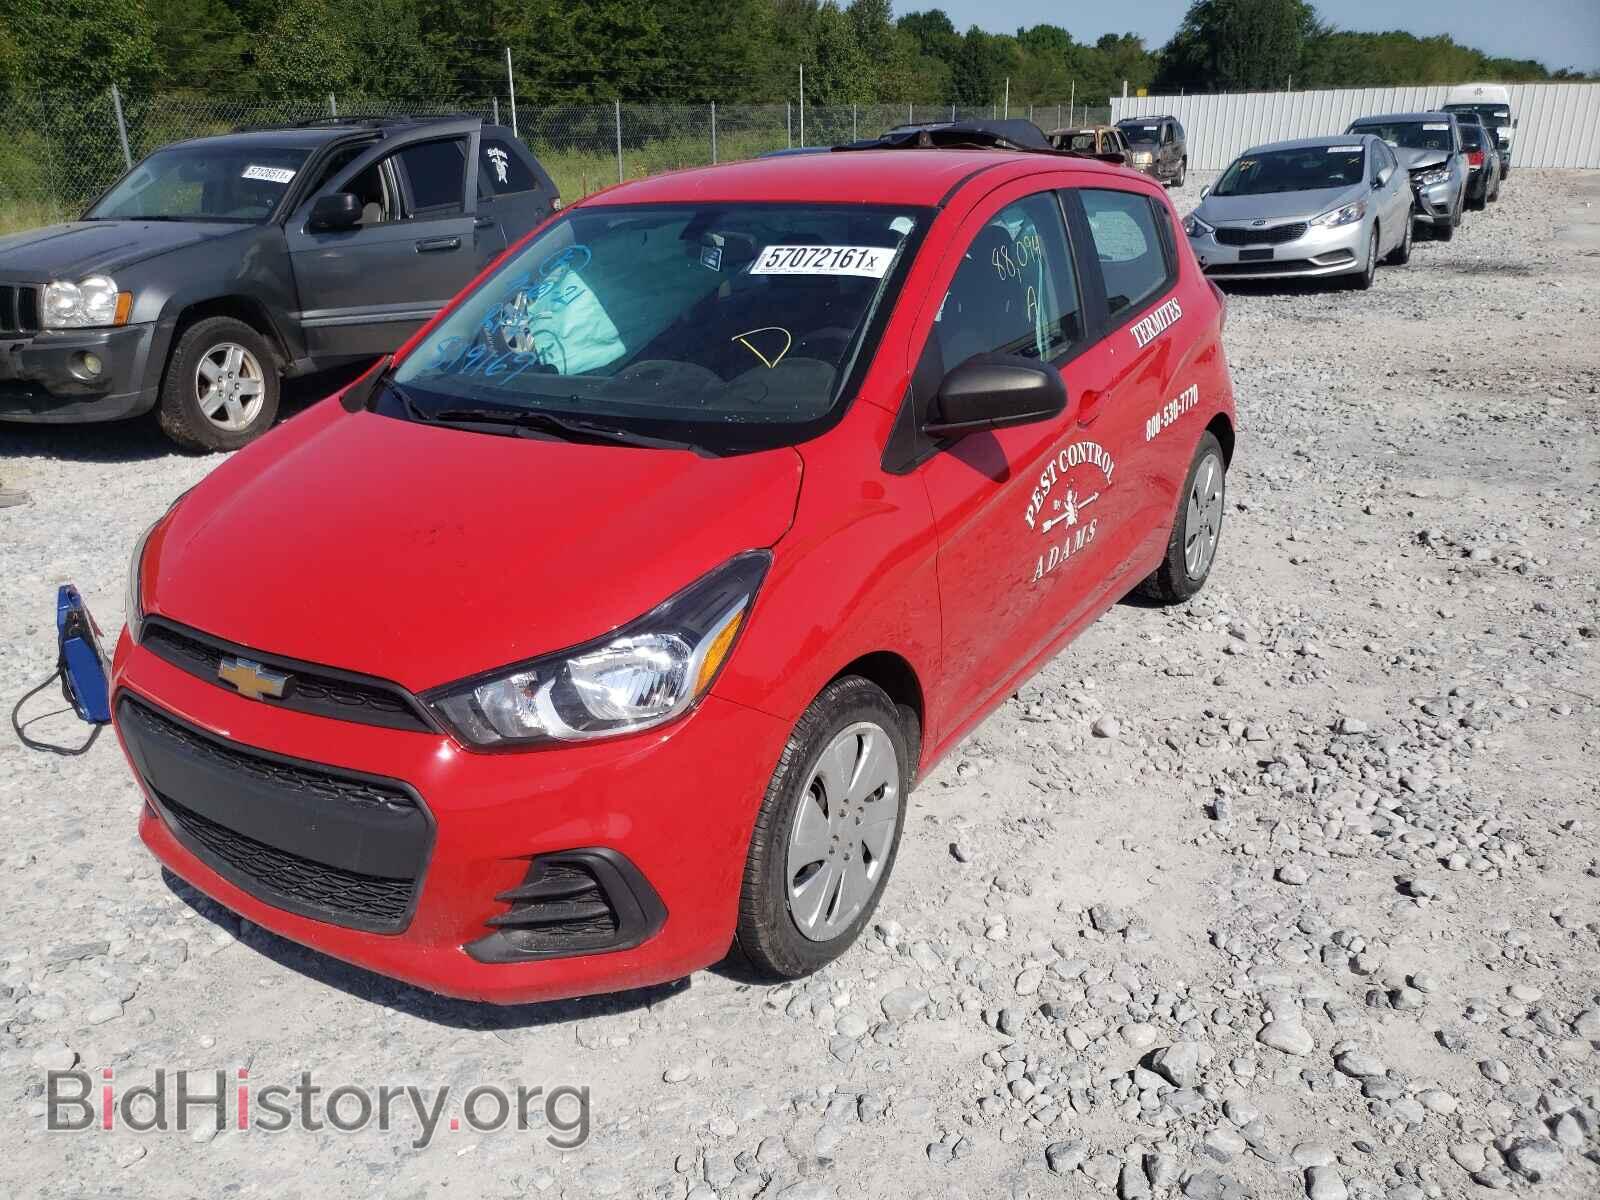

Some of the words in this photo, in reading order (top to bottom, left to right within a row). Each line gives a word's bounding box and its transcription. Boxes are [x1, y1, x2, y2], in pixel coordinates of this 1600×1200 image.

[1130, 297, 1183, 349] TERMITES
[1145, 384, 1198, 442] 800-530-7770
[1025, 459, 1058, 529] PEST
[1058, 442, 1115, 485] CONTROL
[1032, 518, 1098, 583] ADAMS
